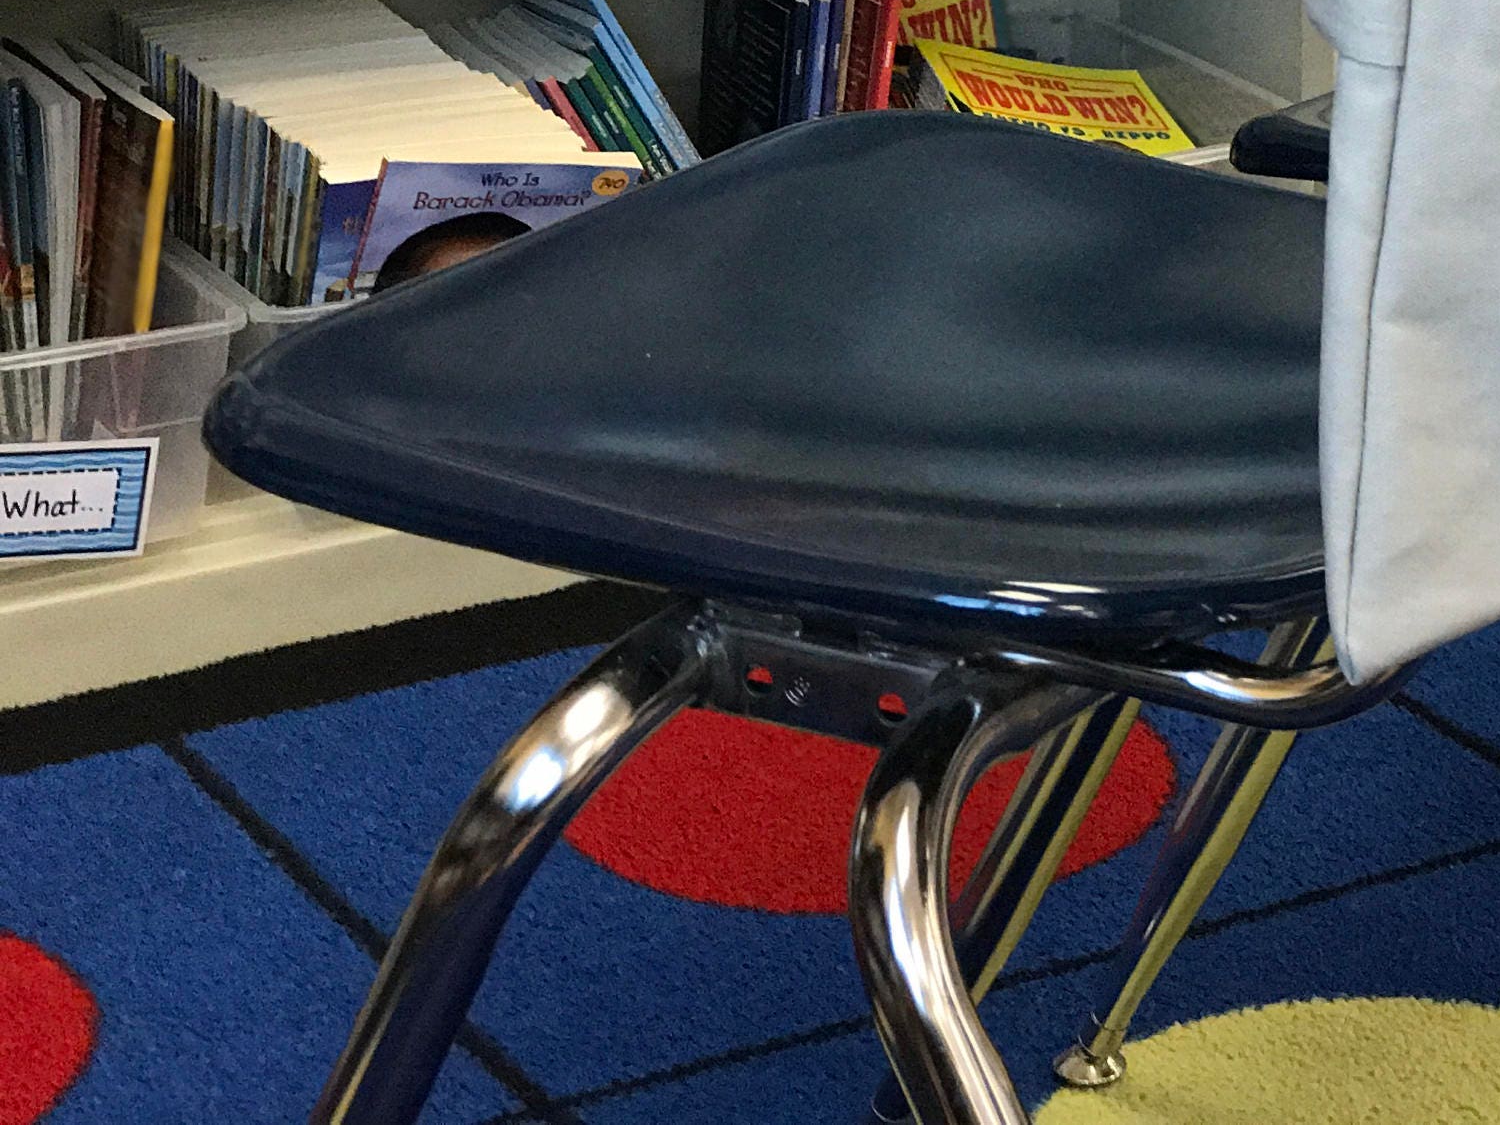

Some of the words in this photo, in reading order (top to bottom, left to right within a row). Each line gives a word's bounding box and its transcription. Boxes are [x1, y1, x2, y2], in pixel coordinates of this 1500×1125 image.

[1016, 74, 1069, 92] WHO
[955, 70, 1070, 117] WOULD
[1066, 94, 1154, 126] WIN?
[1103, 130, 1170, 140] HIPPO
[481, 172, 518, 187] Who
[522, 173, 540, 187] Is
[414, 191, 495, 210] Barack
[501, 190, 591, 207] Obama?
